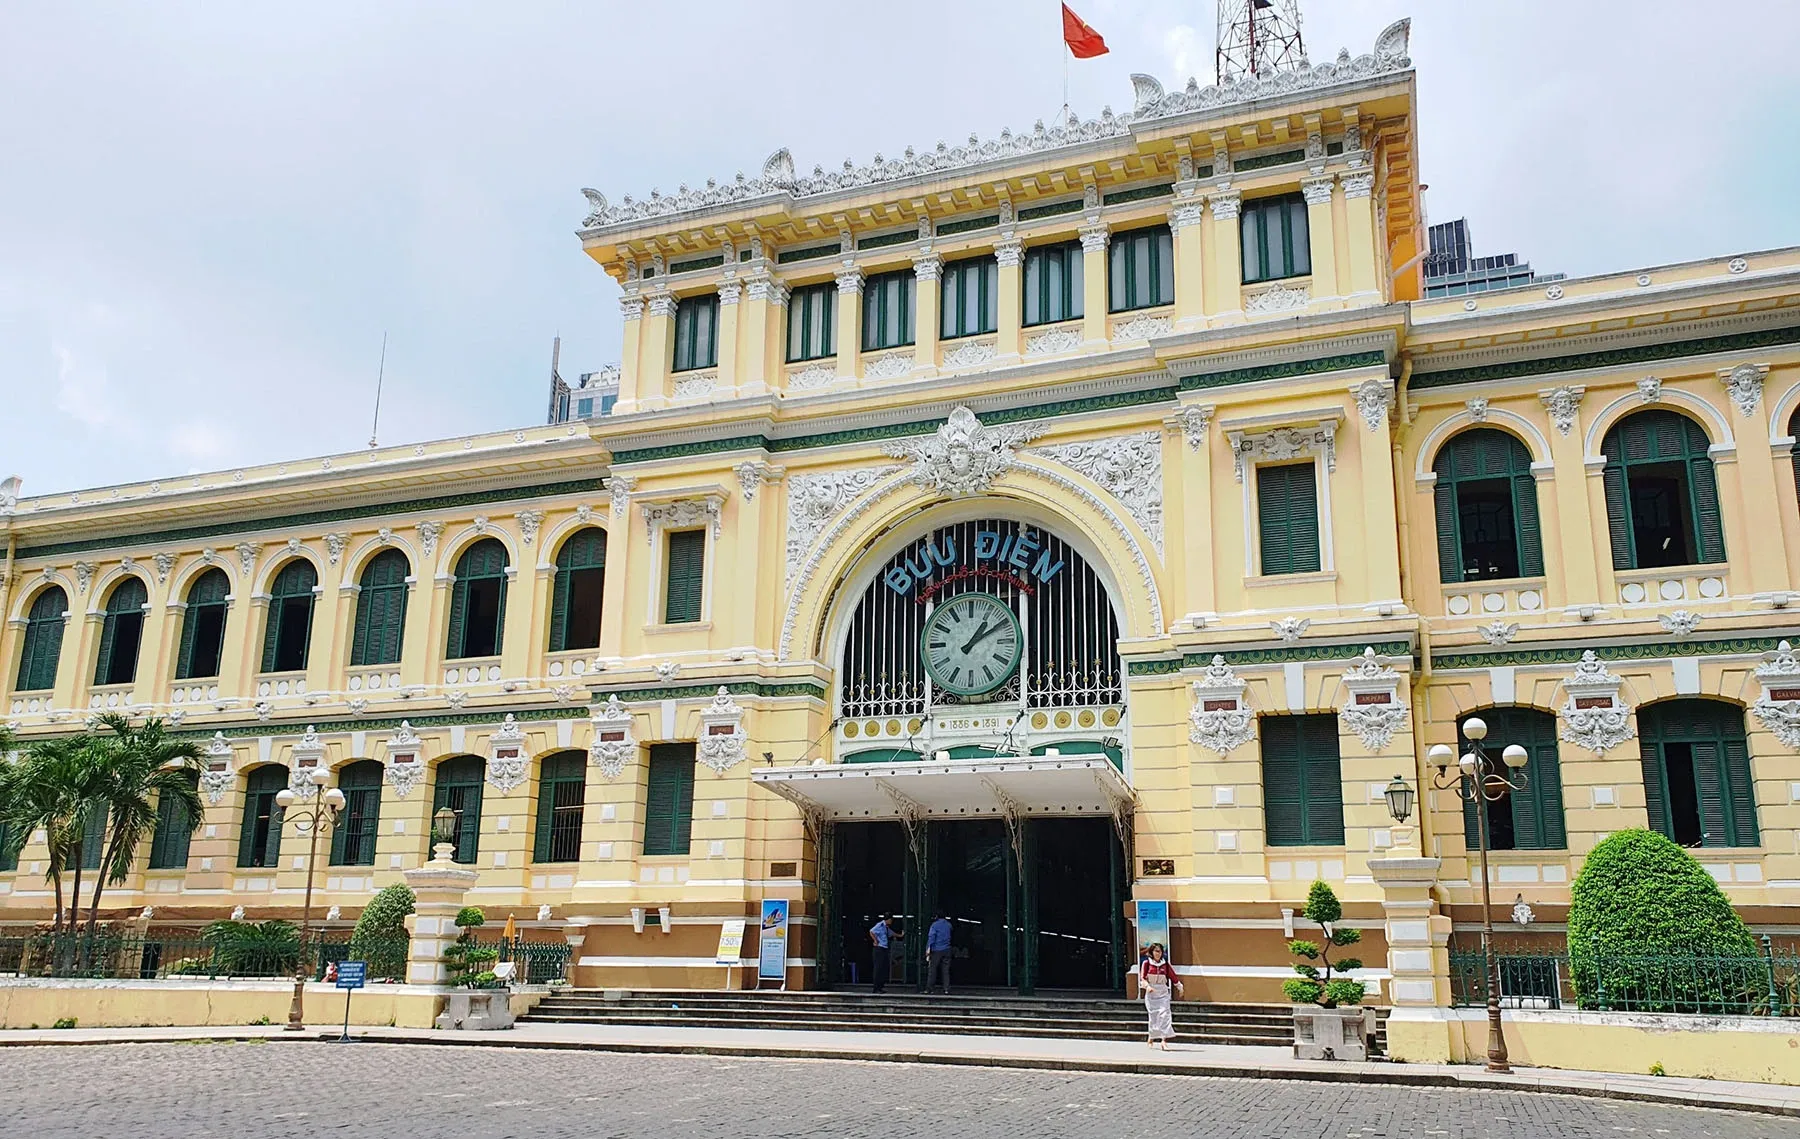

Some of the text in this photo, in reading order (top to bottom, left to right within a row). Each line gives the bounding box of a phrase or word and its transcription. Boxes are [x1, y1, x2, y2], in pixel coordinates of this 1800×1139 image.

[884, 531, 1065, 596] BƯU ĐIỆN
[982, 717, 1000, 728] 1891
